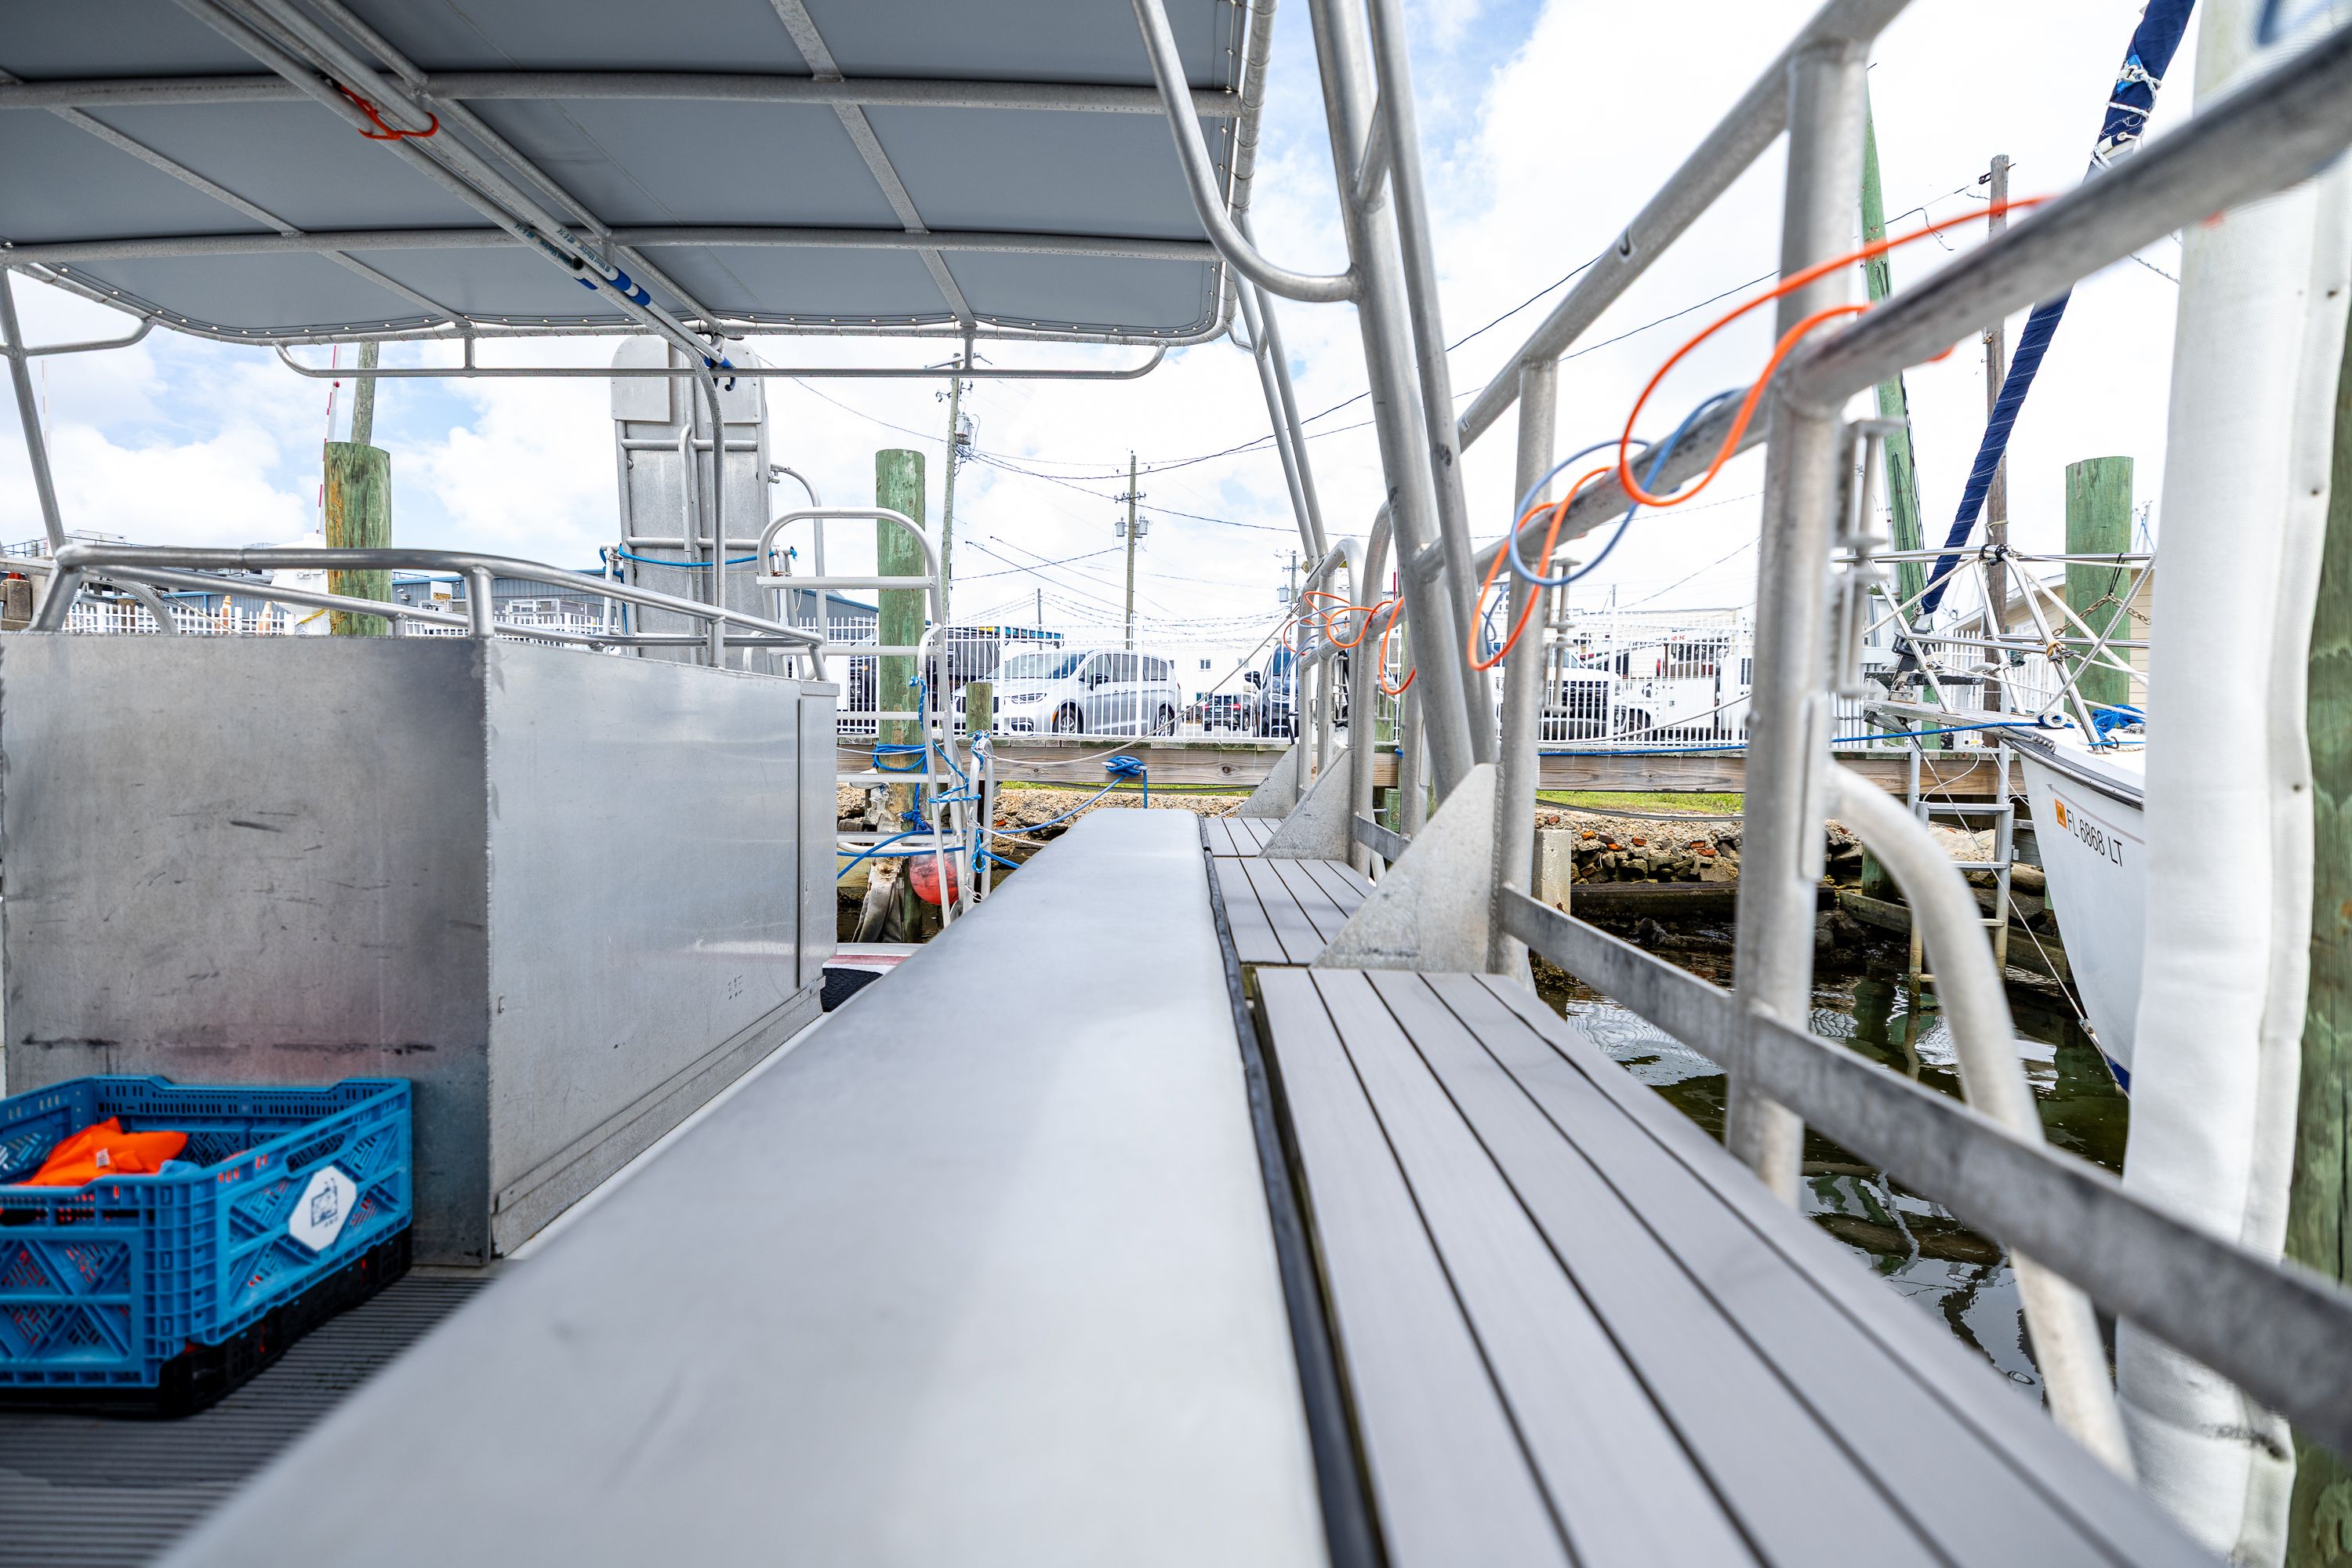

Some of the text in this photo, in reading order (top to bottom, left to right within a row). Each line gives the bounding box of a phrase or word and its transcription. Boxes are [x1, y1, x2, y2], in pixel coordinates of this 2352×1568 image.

[596, 257, 606, 269] West
[2067, 809, 2079, 838] FL
[2079, 818, 2105, 856] 6868
[2107, 836, 2123, 866] LT
